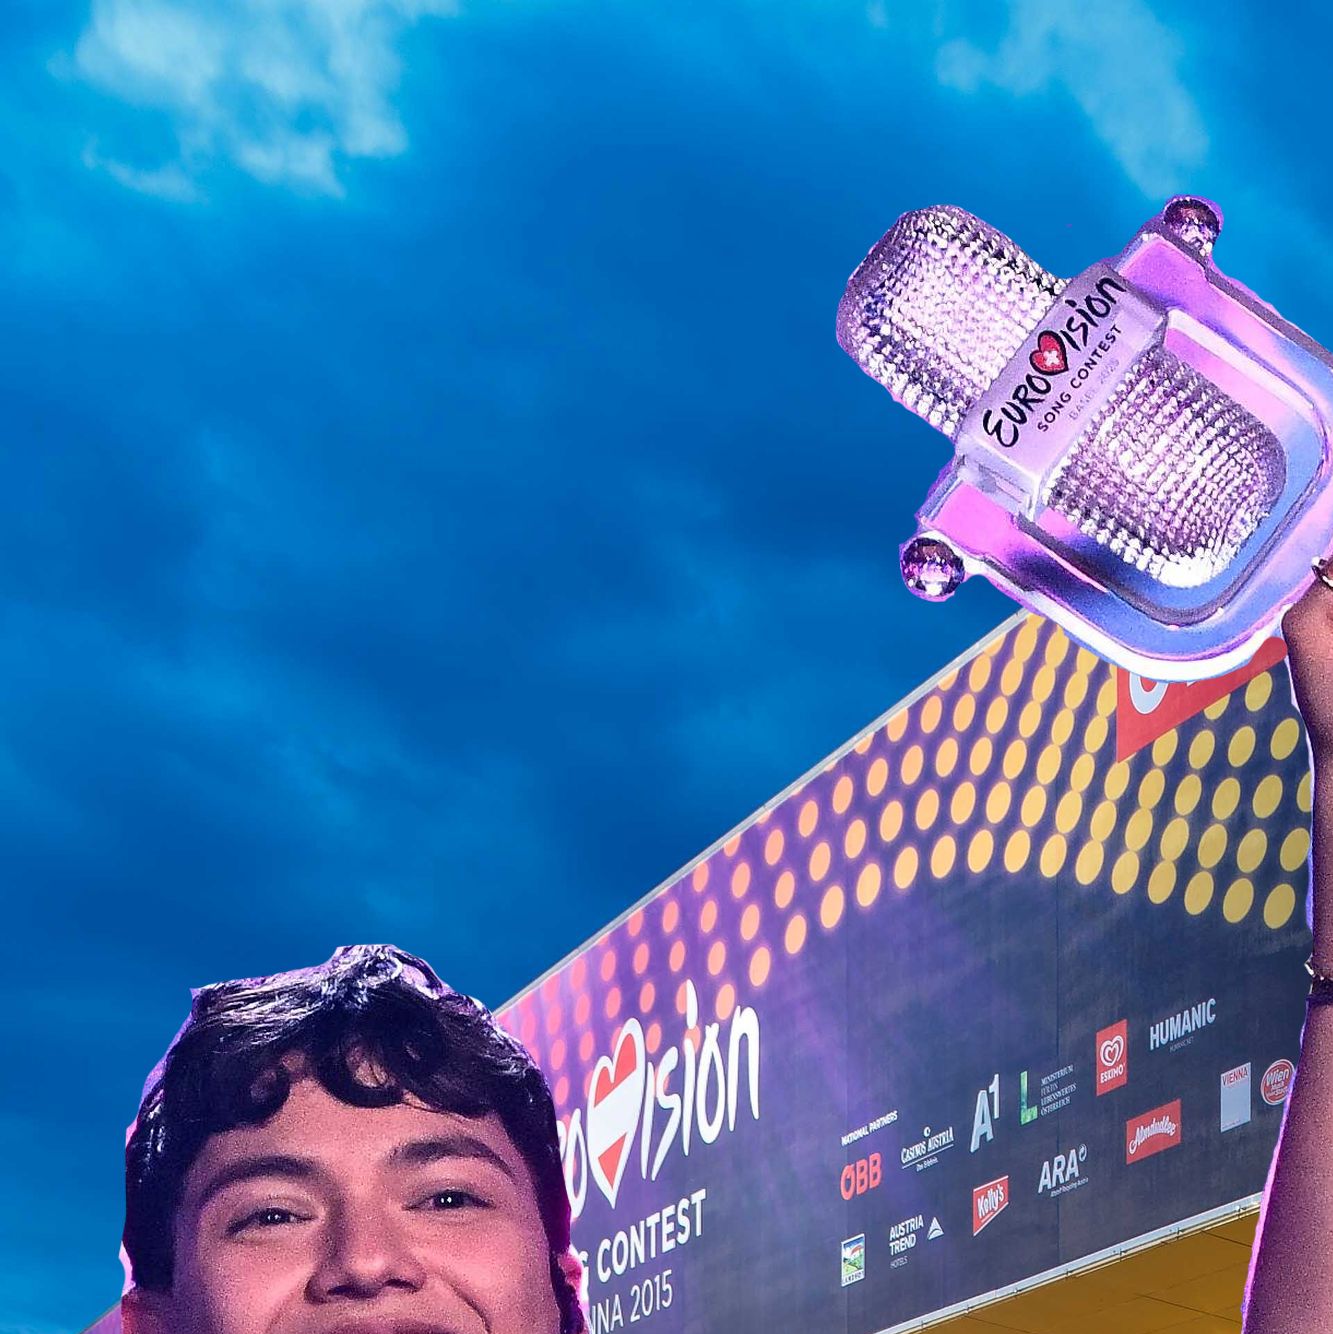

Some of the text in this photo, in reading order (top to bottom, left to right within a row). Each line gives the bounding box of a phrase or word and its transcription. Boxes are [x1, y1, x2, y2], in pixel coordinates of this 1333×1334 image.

[1037, 323, 1122, 433] SONG CONTEST
[1150, 998, 1216, 1051] HUMANIC
[1100, 1064, 1124, 1084] ESKIMO
[1222, 1066, 1249, 1087] VIENNA
[841, 1110, 898, 1147] NATIONAL PARTNERS
[970, 1073, 1000, 1153] A1
[1038, 1148, 1080, 1194] ARA
[978, 1183, 1005, 1219] Kelly's
[597, 1188, 707, 1283] CONTEST
[889, 1214, 924, 1241] AUSTRIA
[889, 1233, 917, 1256] TREND
[630, 1269, 673, 1323] 2015
